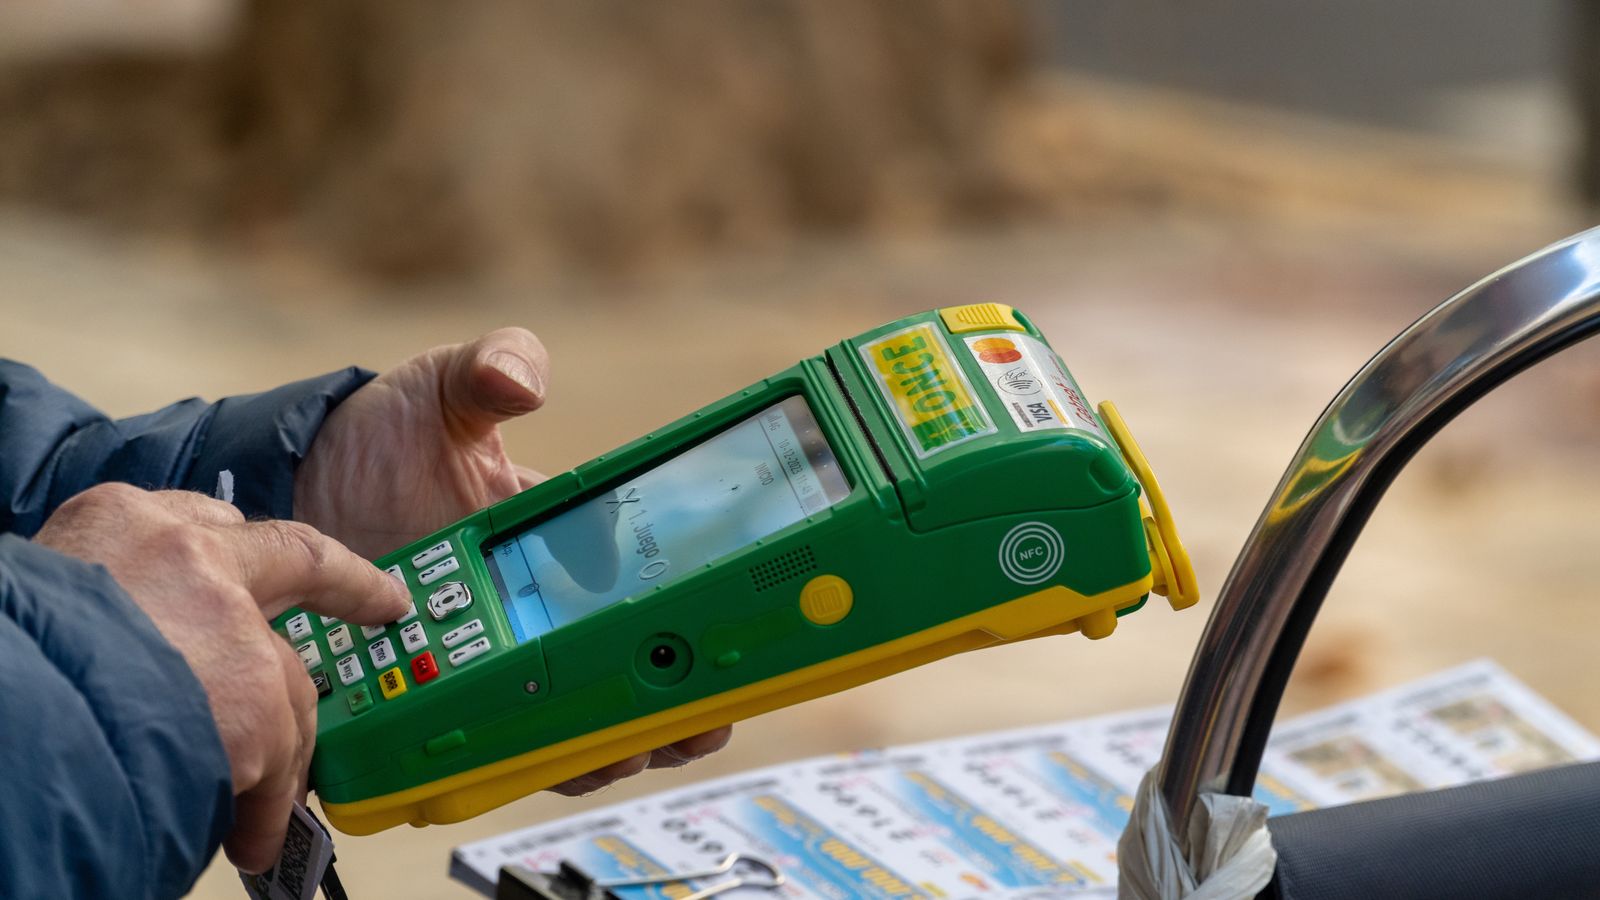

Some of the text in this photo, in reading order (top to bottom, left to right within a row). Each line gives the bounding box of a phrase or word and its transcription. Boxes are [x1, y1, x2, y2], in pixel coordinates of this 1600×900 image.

[881, 335, 957, 413] ONCE
[1026, 402, 1053, 424] VISA
[754, 462, 775, 487] INICIO
[1019, 546, 1044, 561] NFC
[328, 627, 342, 637] 8
[404, 623, 419, 633] 3
[370, 640, 385, 650] 6
[338, 656, 353, 666] 9
[383, 671, 399, 692] BORR
